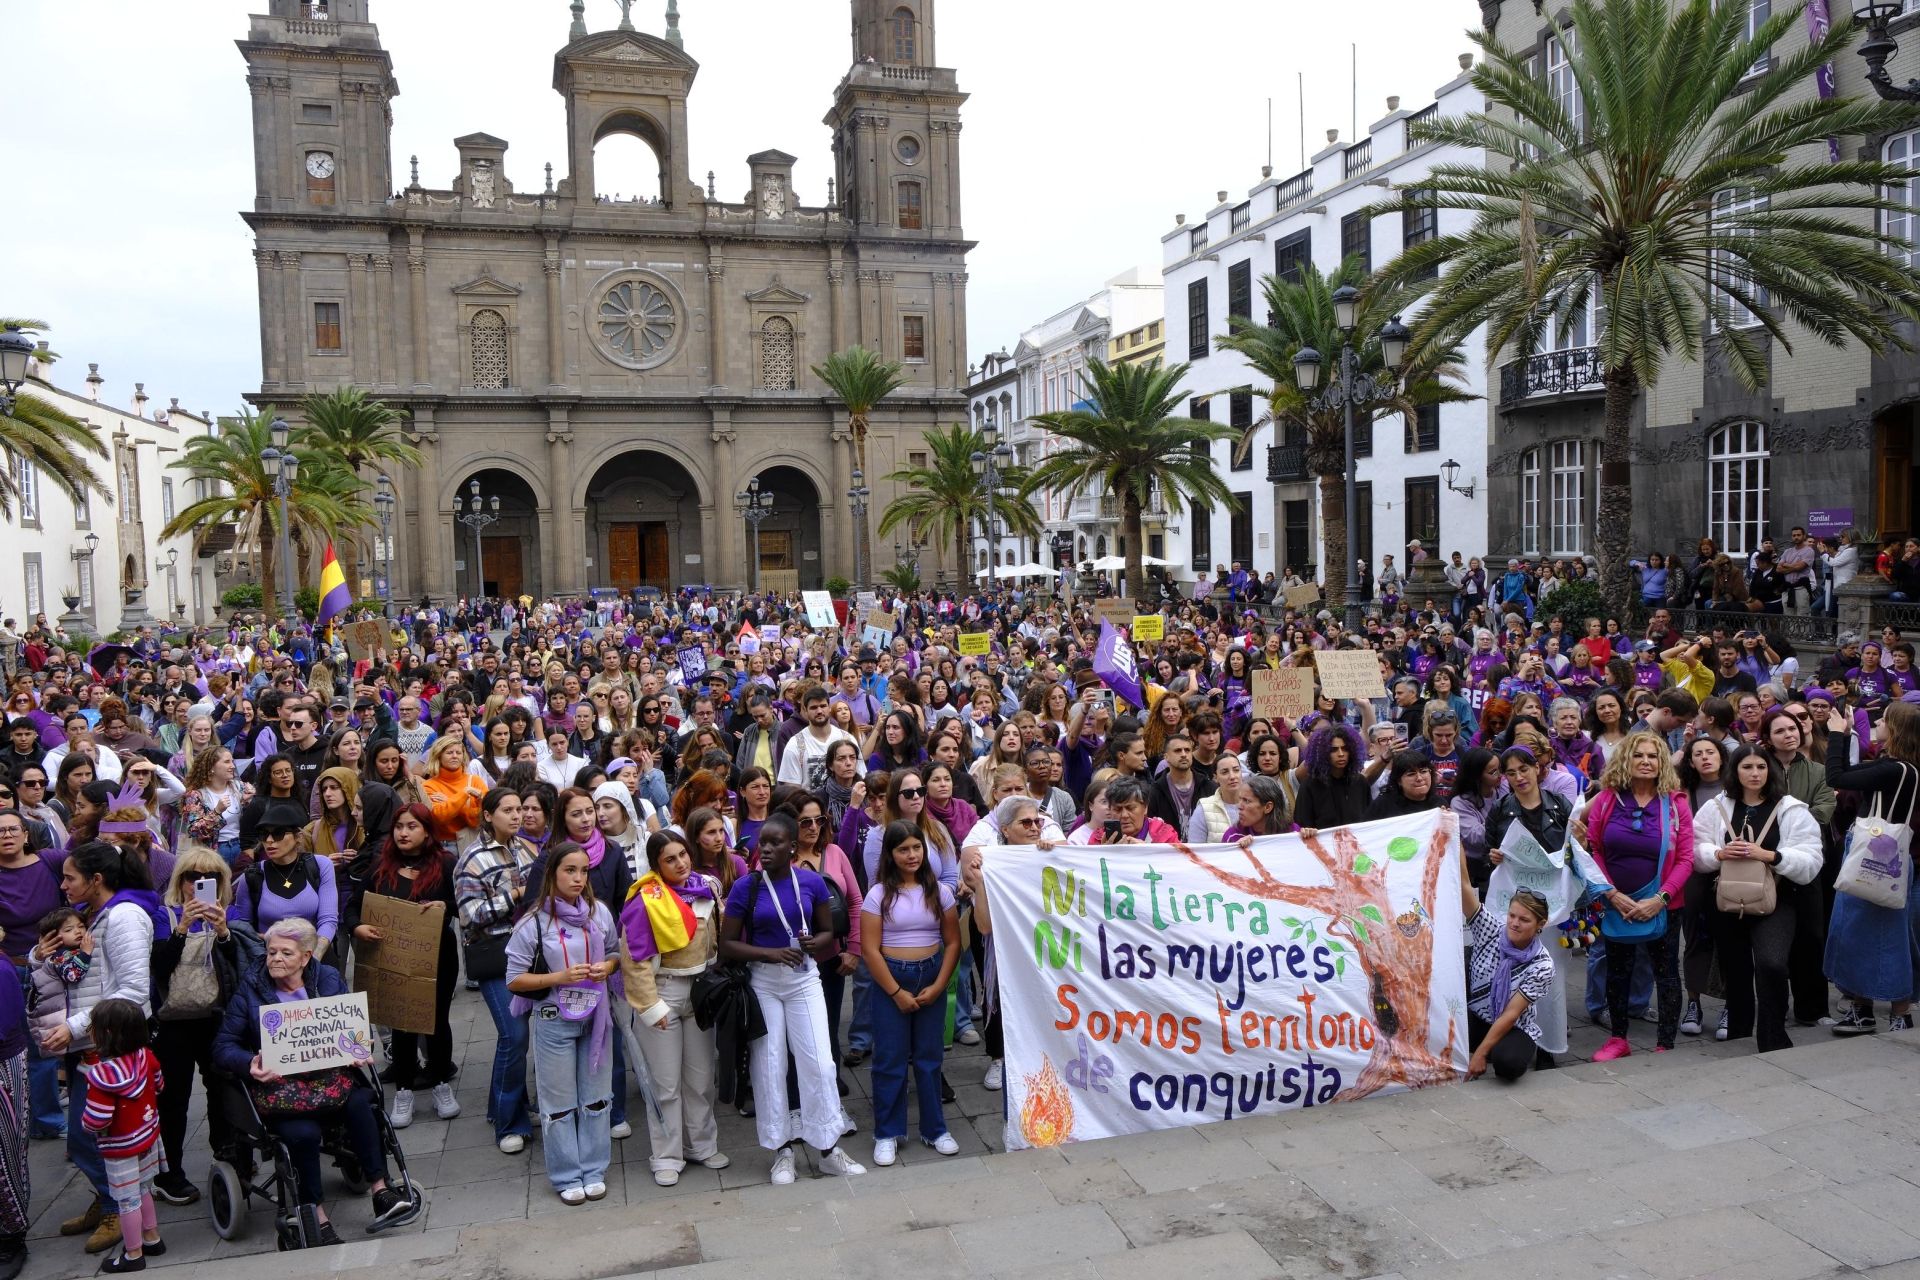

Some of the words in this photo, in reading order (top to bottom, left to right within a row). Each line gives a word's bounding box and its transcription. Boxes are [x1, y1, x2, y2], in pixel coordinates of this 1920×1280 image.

[1809, 514, 1830, 522] Cordial
[1259, 669, 1300, 681] NUESTROS
[1268, 679, 1302, 691] CUERPOS
[1256, 693, 1301, 705] NUESTRAS
[1264, 703, 1311, 718] FRONTERAS
[1040, 866, 1087, 918] Ni
[1100, 857, 1137, 922] la
[1143, 864, 1270, 937] tierra
[1034, 920, 1084, 973] Ni
[1098, 923, 1157, 981] las
[1168, 940, 1336, 1011] mujeres
[283, 1006, 314, 1028] AMIGA
[314, 1001, 365, 1021] ESCUCHA
[1054, 983, 1203, 1055] Somos
[272, 1028, 288, 1045] EN
[290, 1019, 354, 1039] CARNAVAL
[288, 1035, 335, 1049] TAMBIEN
[279, 1053, 298, 1064] SE
[300, 1046, 343, 1063] LUCHA
[1065, 1032, 1115, 1093] de
[1129, 1053, 1343, 1121] conquista
